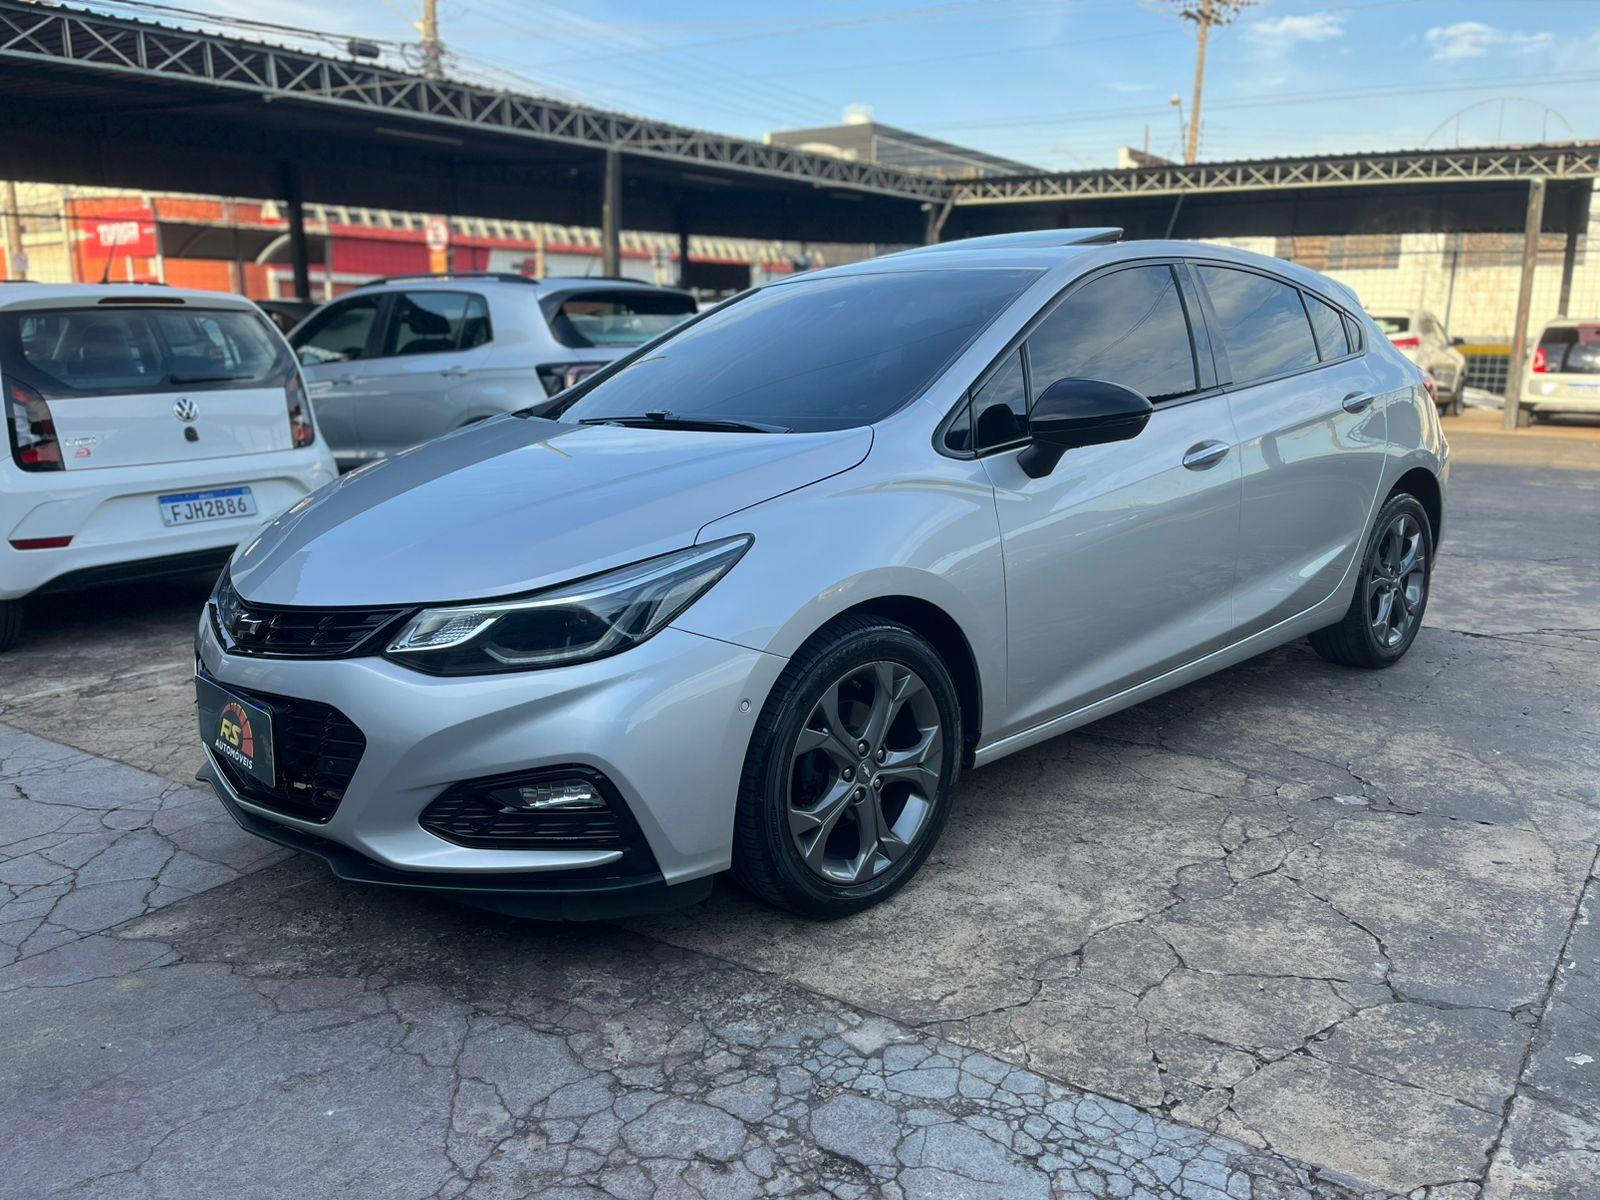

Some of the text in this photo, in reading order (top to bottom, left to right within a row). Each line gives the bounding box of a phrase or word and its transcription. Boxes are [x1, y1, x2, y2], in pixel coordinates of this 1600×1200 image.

[170, 497, 247, 522] FJH2B86
[220, 718, 241, 746] RS
[214, 738, 253, 770] AUTOMÓVEIS
